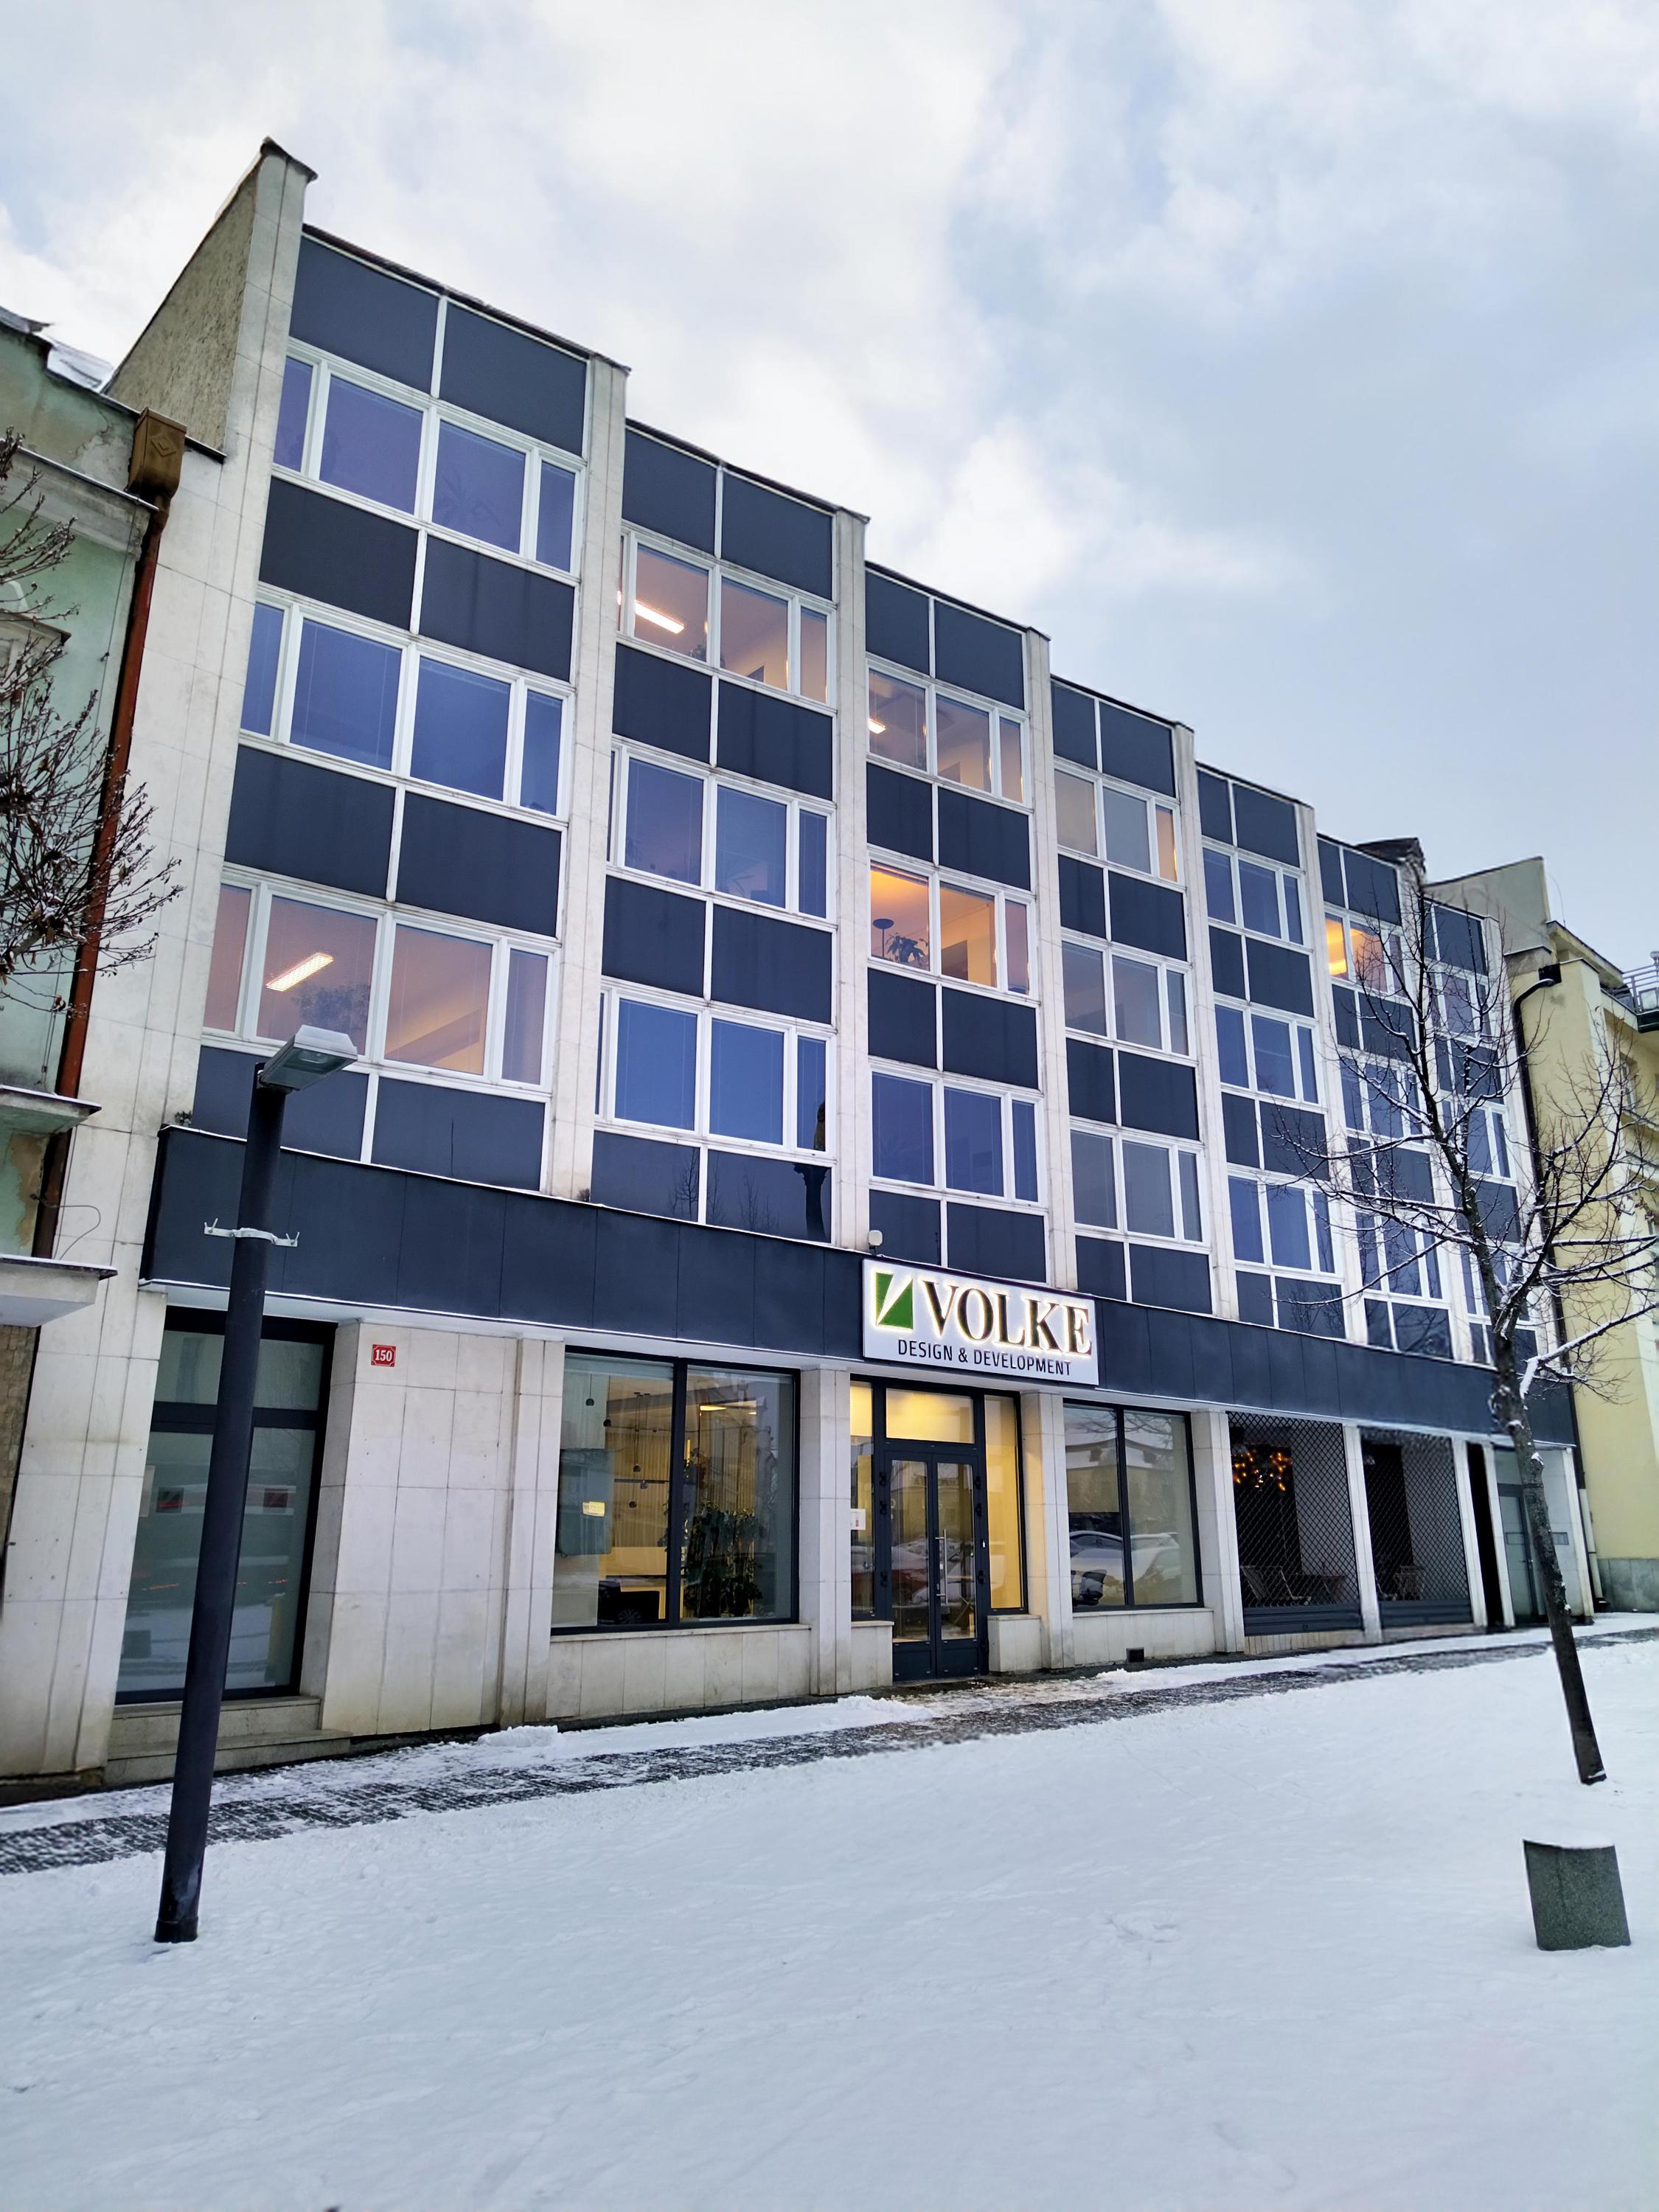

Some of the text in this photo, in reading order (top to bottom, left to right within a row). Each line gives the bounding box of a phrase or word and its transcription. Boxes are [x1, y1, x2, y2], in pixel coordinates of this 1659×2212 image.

[921, 1281, 1092, 1356] VOLKE
[375, 1349, 392, 1362] 150
[898, 1339, 1071, 1376] DESIGN & DEVELOPMENT
